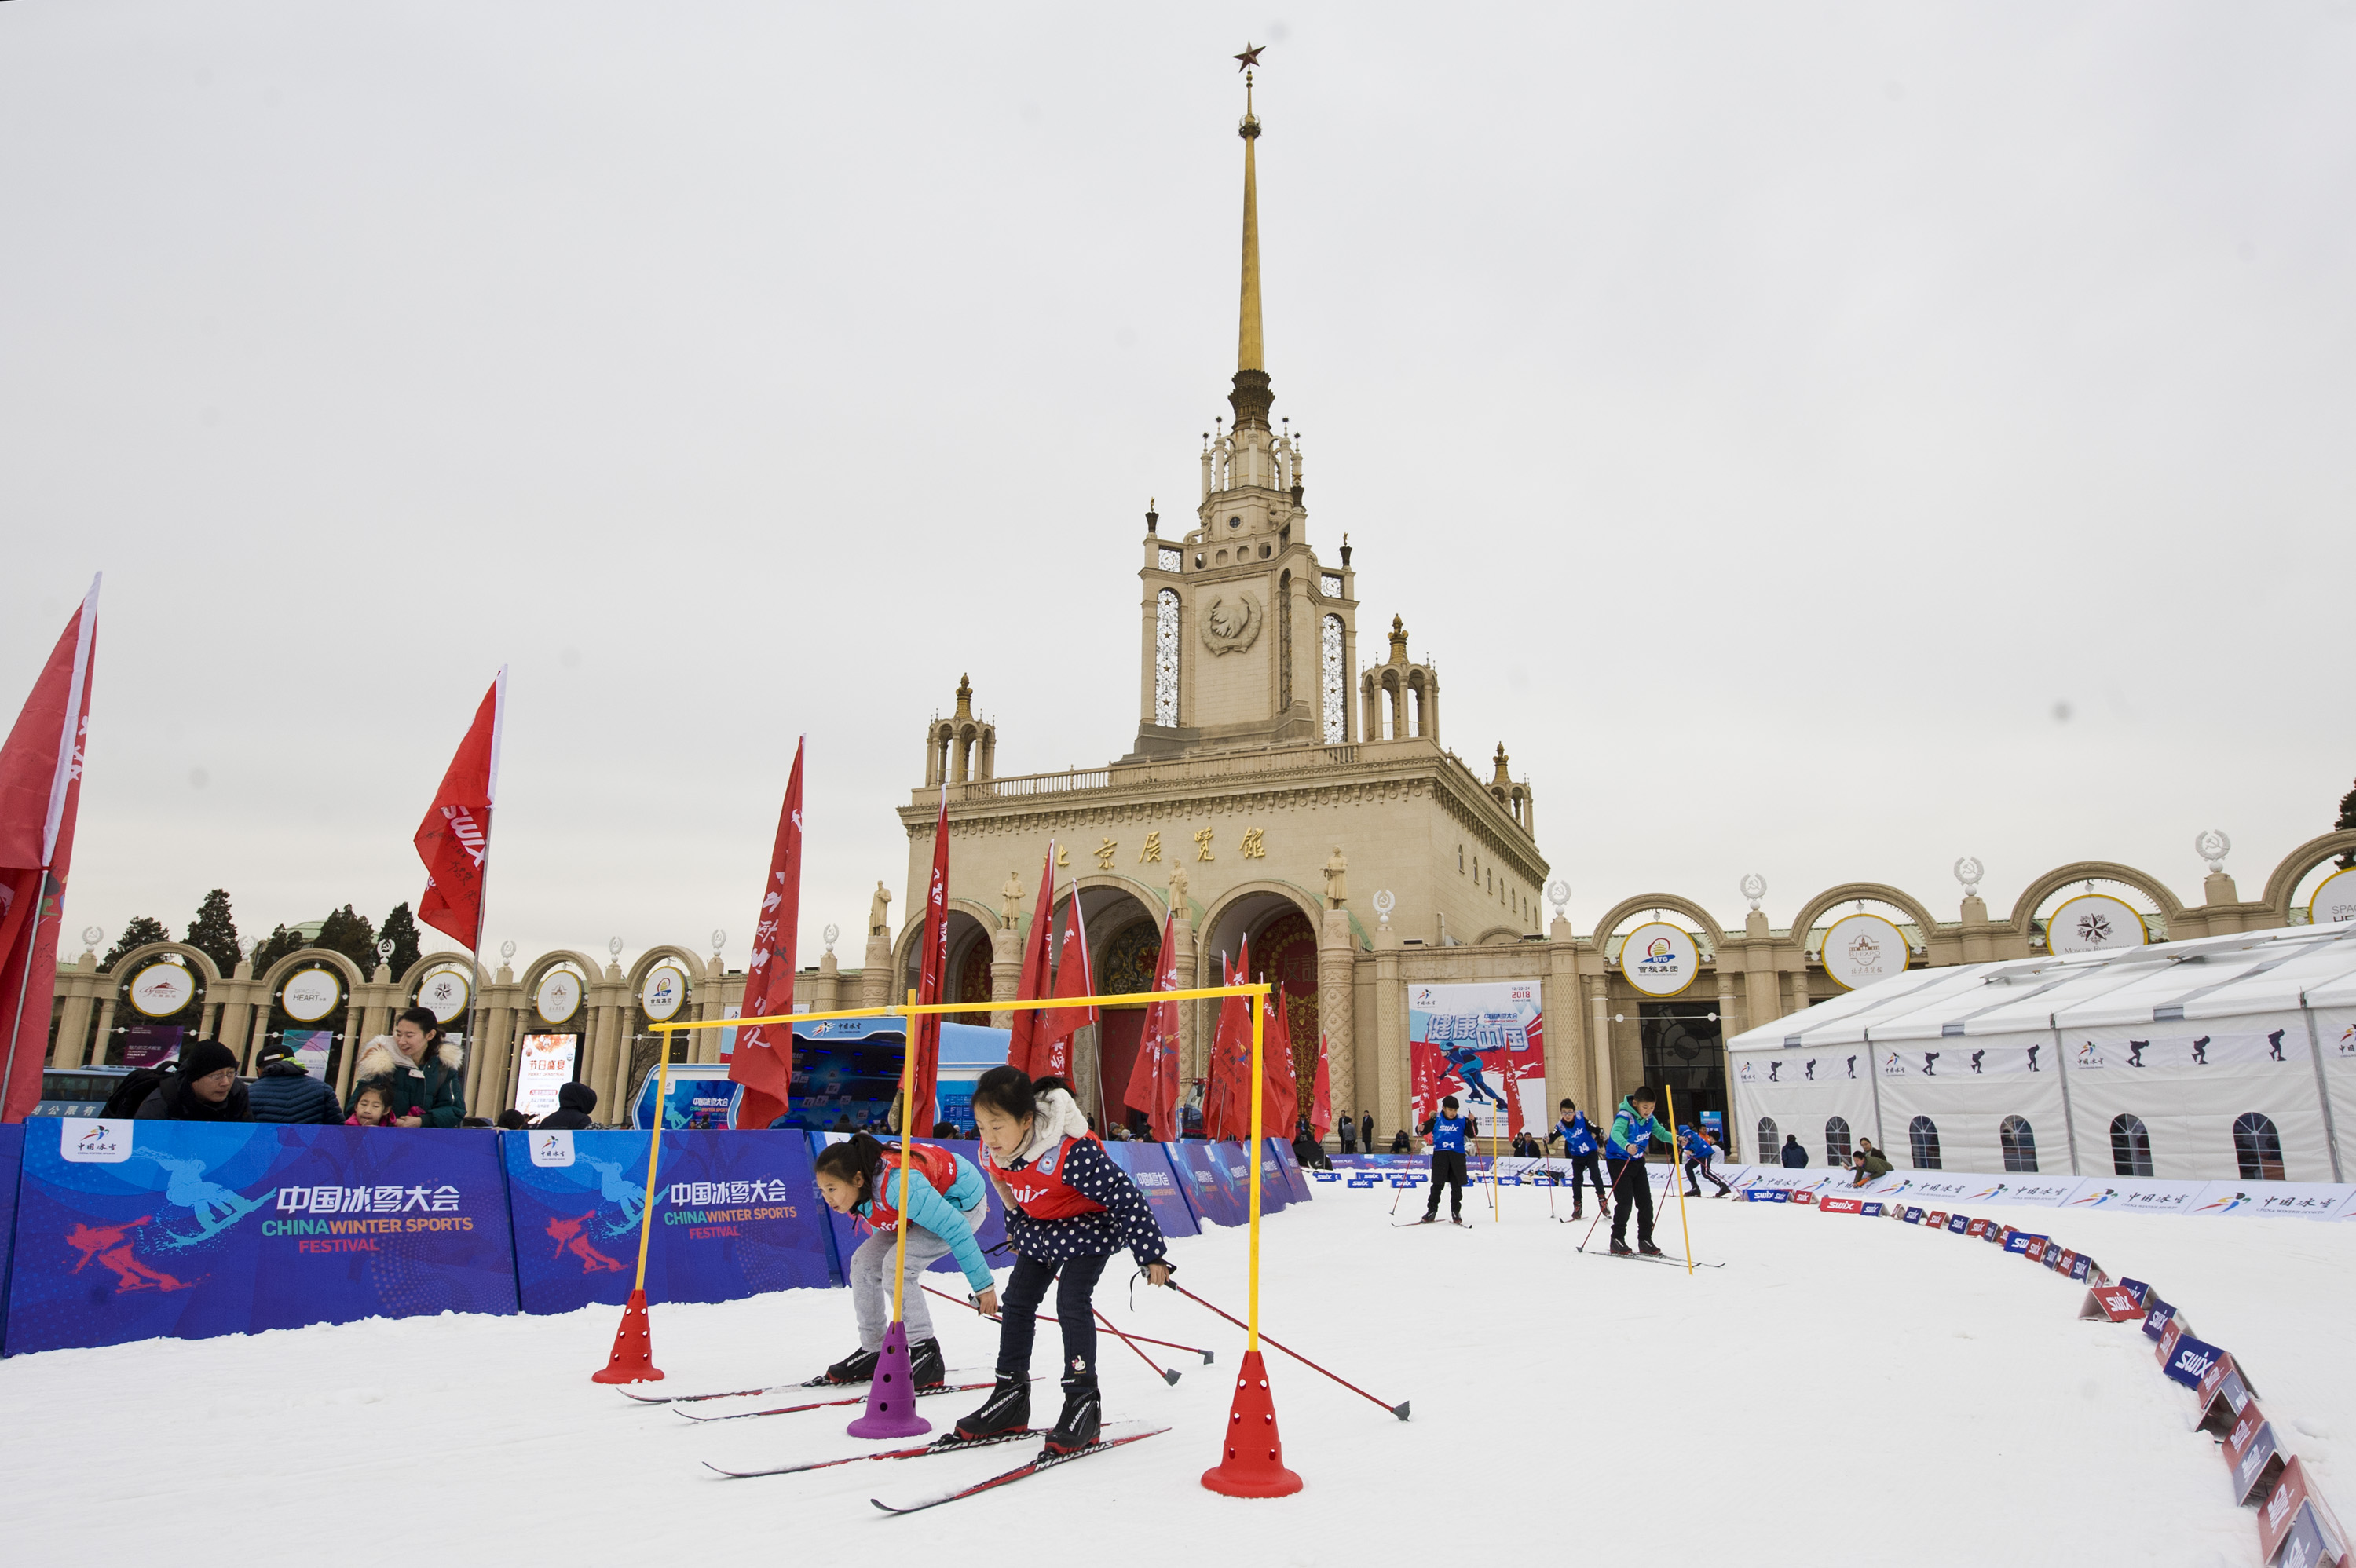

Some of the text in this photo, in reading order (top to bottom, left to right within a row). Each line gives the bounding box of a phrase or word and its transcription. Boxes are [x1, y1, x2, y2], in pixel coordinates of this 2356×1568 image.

[2332, 905, 2356, 915] SPA
[1579, 1142, 1590, 1153] 14
[671, 1179, 787, 1207] 中国冰雪大会
[1920, 1182, 1965, 1193] 中国冰雪
[2017, 1186, 2067, 1195] 中国冰雪
[276, 1185, 460, 1214] 中国冰雪大会
[2128, 1192, 2189, 1204] 中国冰雪
[2263, 1196, 2336, 1208] 中国冰雪
[754, 1206, 798, 1220] SPORTS
[1827, 1201, 1854, 1211] swix
[1864, 1204, 1879, 1214] swix
[405, 1217, 474, 1233] SPORTS
[689, 1226, 741, 1240] FESTIVAL
[299, 1238, 380, 1254] FESTIVAL
[2105, 1291, 2134, 1312] swix
[2149, 1310, 2168, 1332] swix
[2175, 1350, 2215, 1379] swix
[980, 1390, 1019, 1419] MADSHUS
[926, 1429, 1049, 1454] MADSHUS
[1034, 1441, 1114, 1471] MADSHUS
